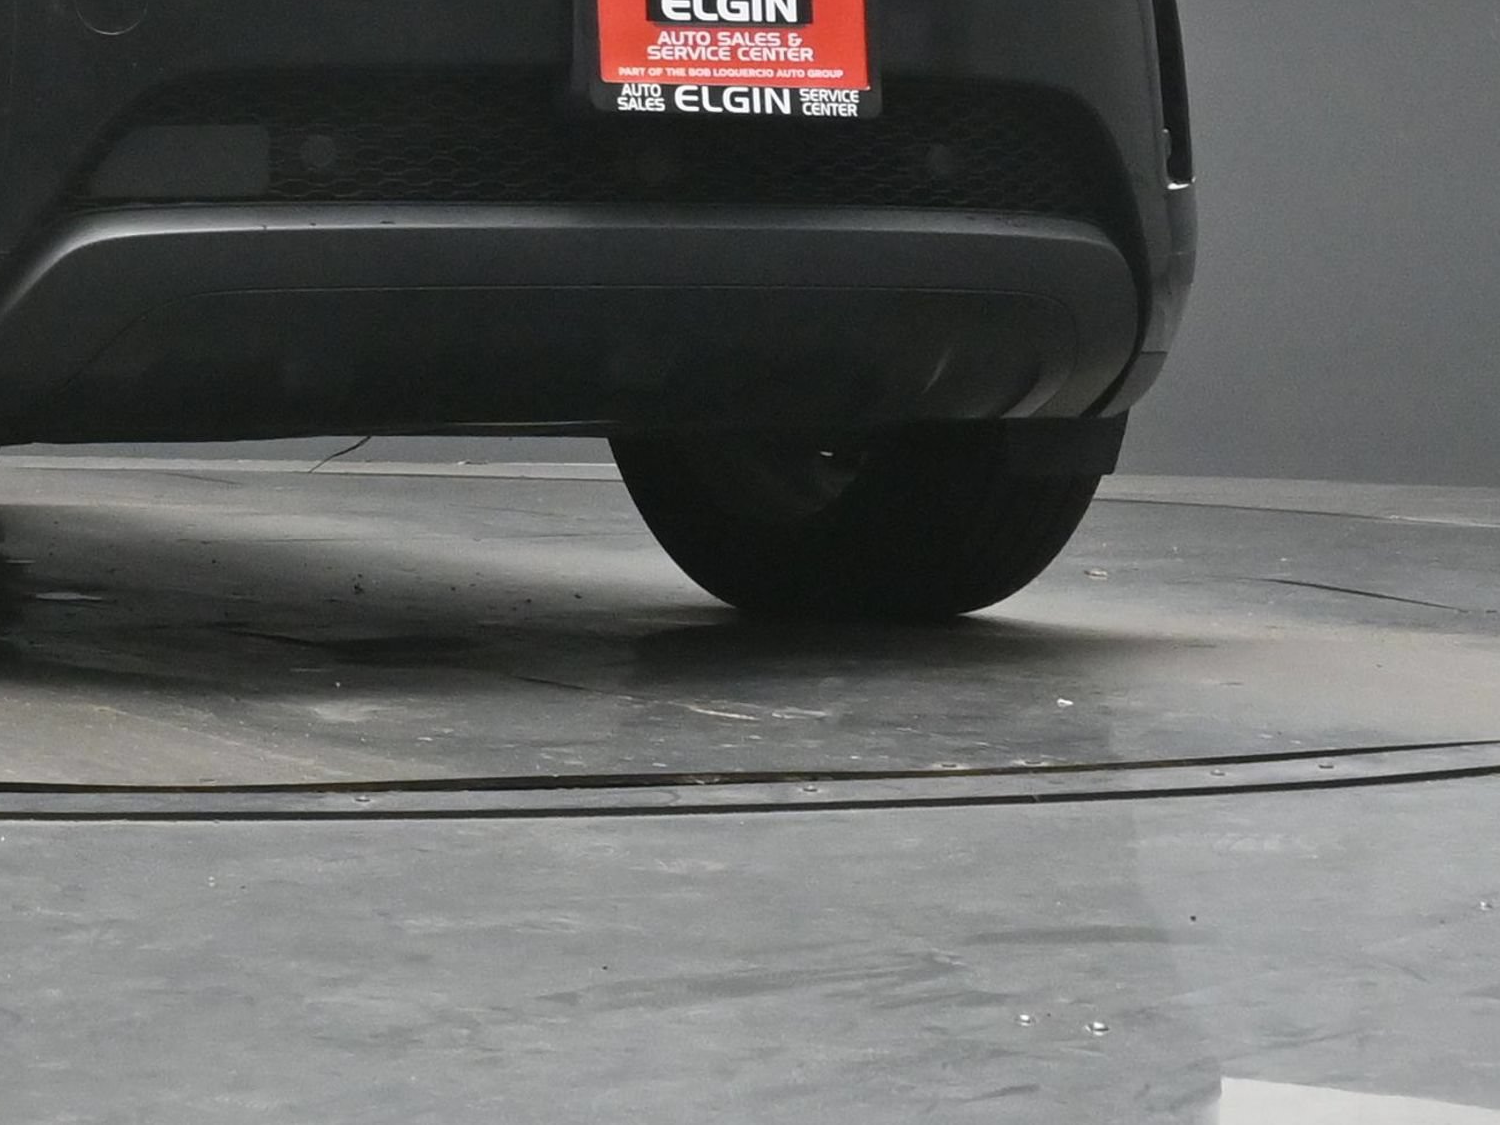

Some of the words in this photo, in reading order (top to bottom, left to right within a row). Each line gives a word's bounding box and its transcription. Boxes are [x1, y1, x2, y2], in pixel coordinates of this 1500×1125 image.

[657, 31, 711, 46] AUTO
[717, 32, 781, 47] SALES
[788, 33, 802, 47] &
[647, 45, 731, 61] SERVICE
[738, 46, 814, 62] CENTER
[618, 67, 645, 76] PART
[648, 67, 664, 76] OF
[666, 67, 687, 77] THE
[776, 69, 805, 78] AUTO
[807, 69, 844, 79] GROUP
[621, 83, 662, 97] AUTO
[800, 89, 859, 103] SERVICE
[617, 97, 665, 112] SALES
[674, 85, 792, 115] ELGIN
[802, 102, 858, 117] CENTER
